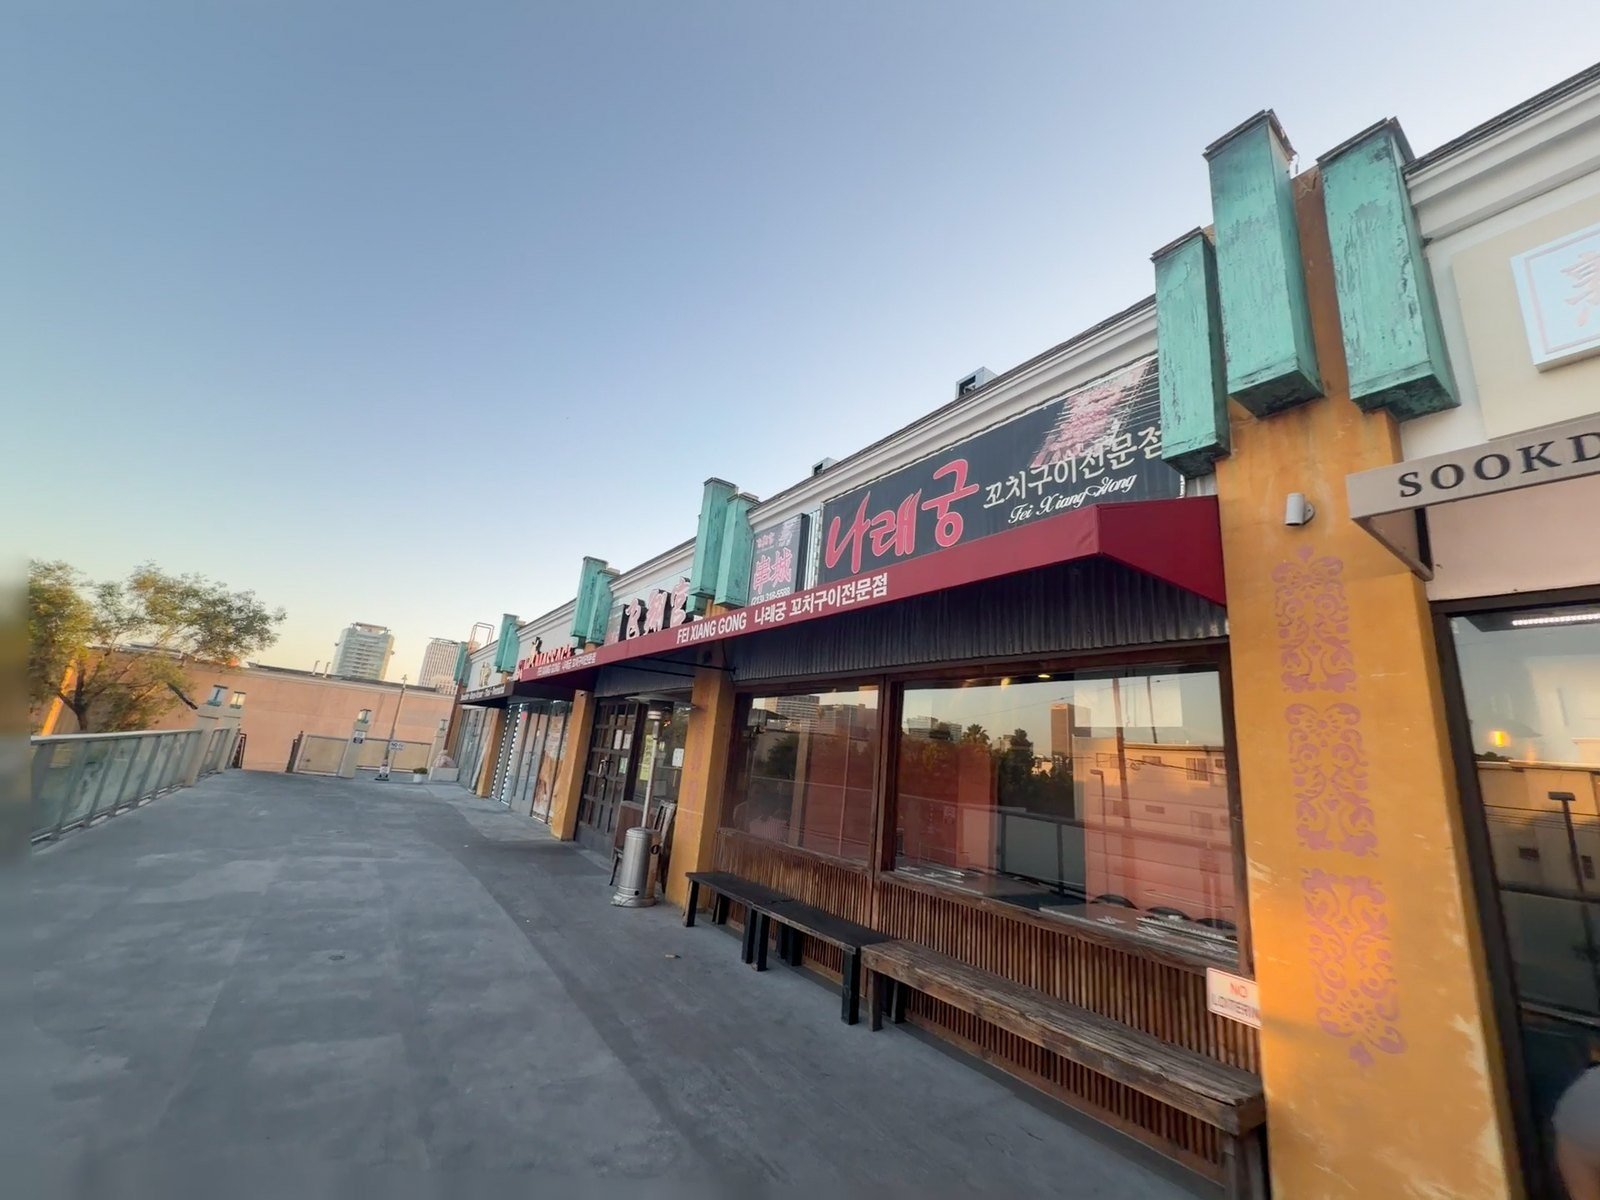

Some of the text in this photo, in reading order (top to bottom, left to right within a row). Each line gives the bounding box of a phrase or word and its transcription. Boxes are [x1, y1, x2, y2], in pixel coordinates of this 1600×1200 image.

[983, 419, 1162, 509] 꼬치구이전문점
[1397, 432, 1600, 498] SOOKD
[824, 458, 980, 574] 나래궁
[1008, 502, 1033, 524] Fei
[1035, 491, 1089, 517] Xiang
[676, 572, 888, 645] FEI XIANG GONG 나래궁 꼬치구이전문점
